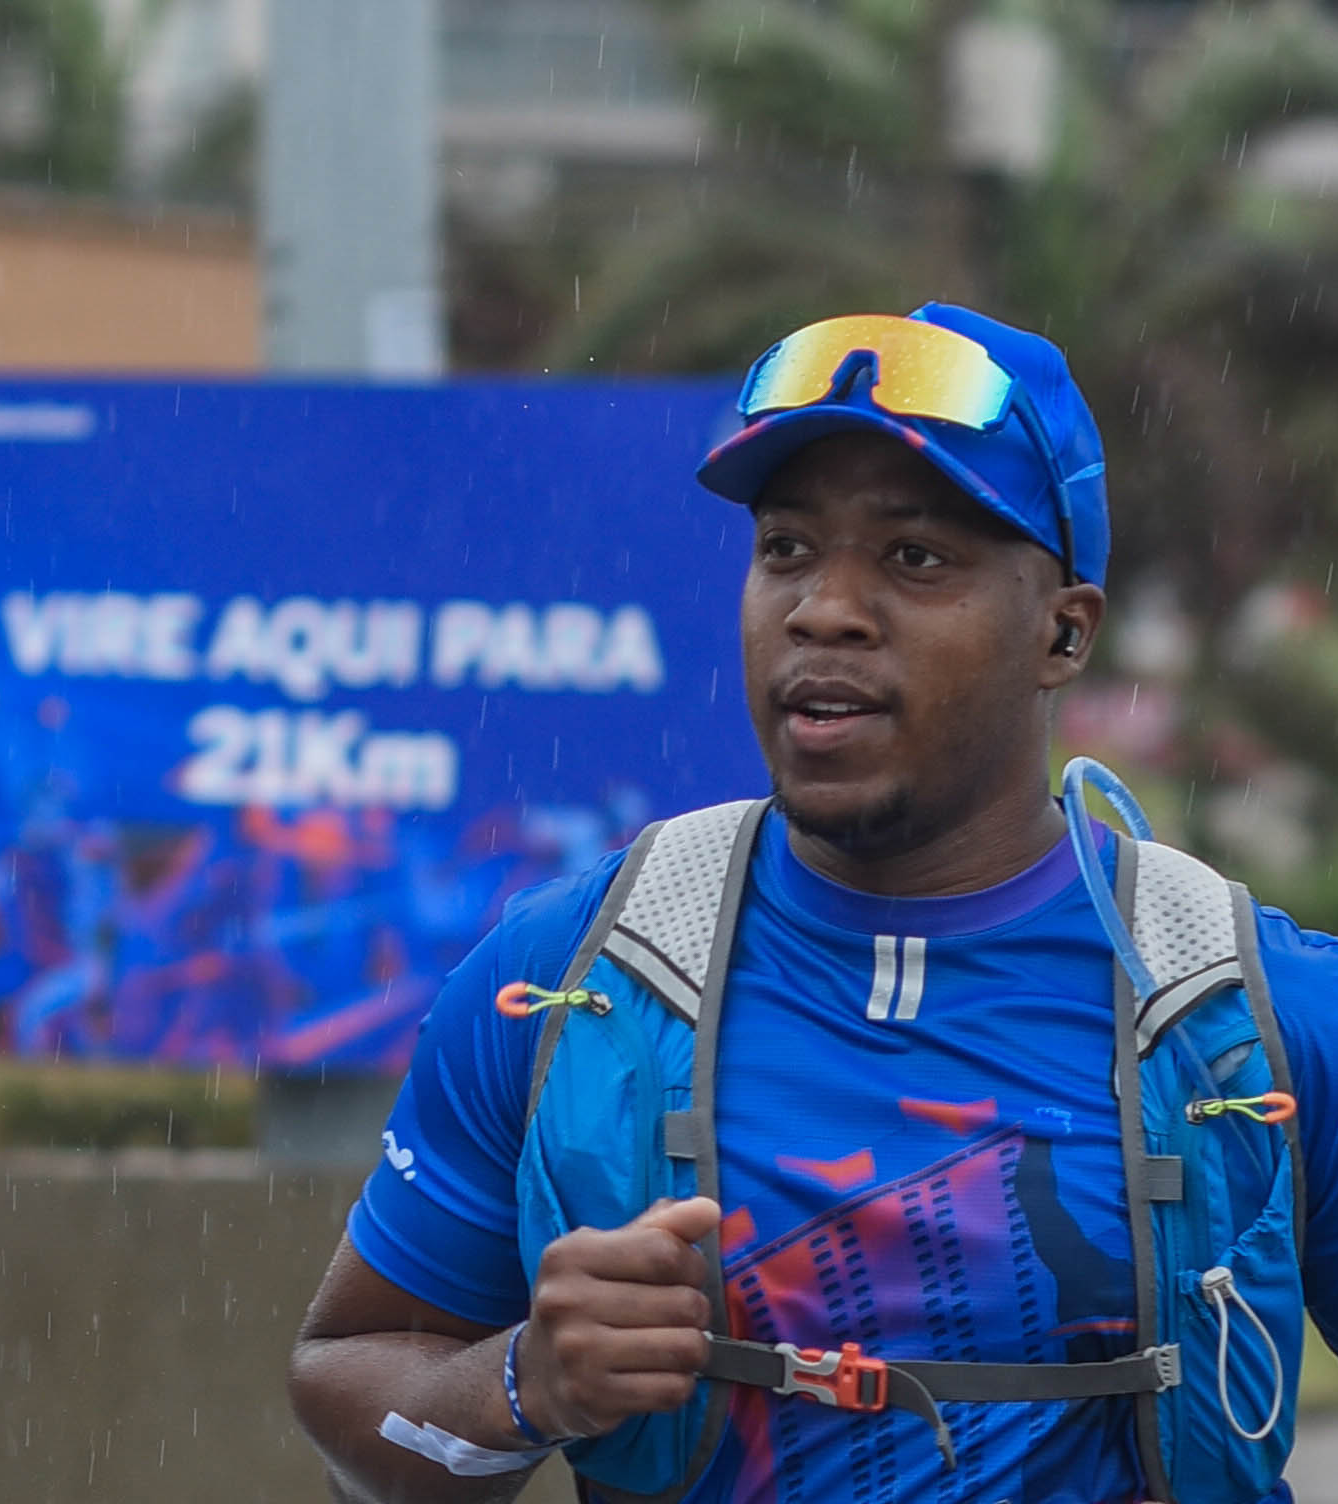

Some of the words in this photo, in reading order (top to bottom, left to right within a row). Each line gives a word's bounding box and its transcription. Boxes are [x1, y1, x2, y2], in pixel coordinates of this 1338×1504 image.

[2, 591, 201, 678] VIRE
[209, 598, 422, 700] AQUI
[434, 601, 663, 693] PARA
[180, 706, 458, 809] 21Km
